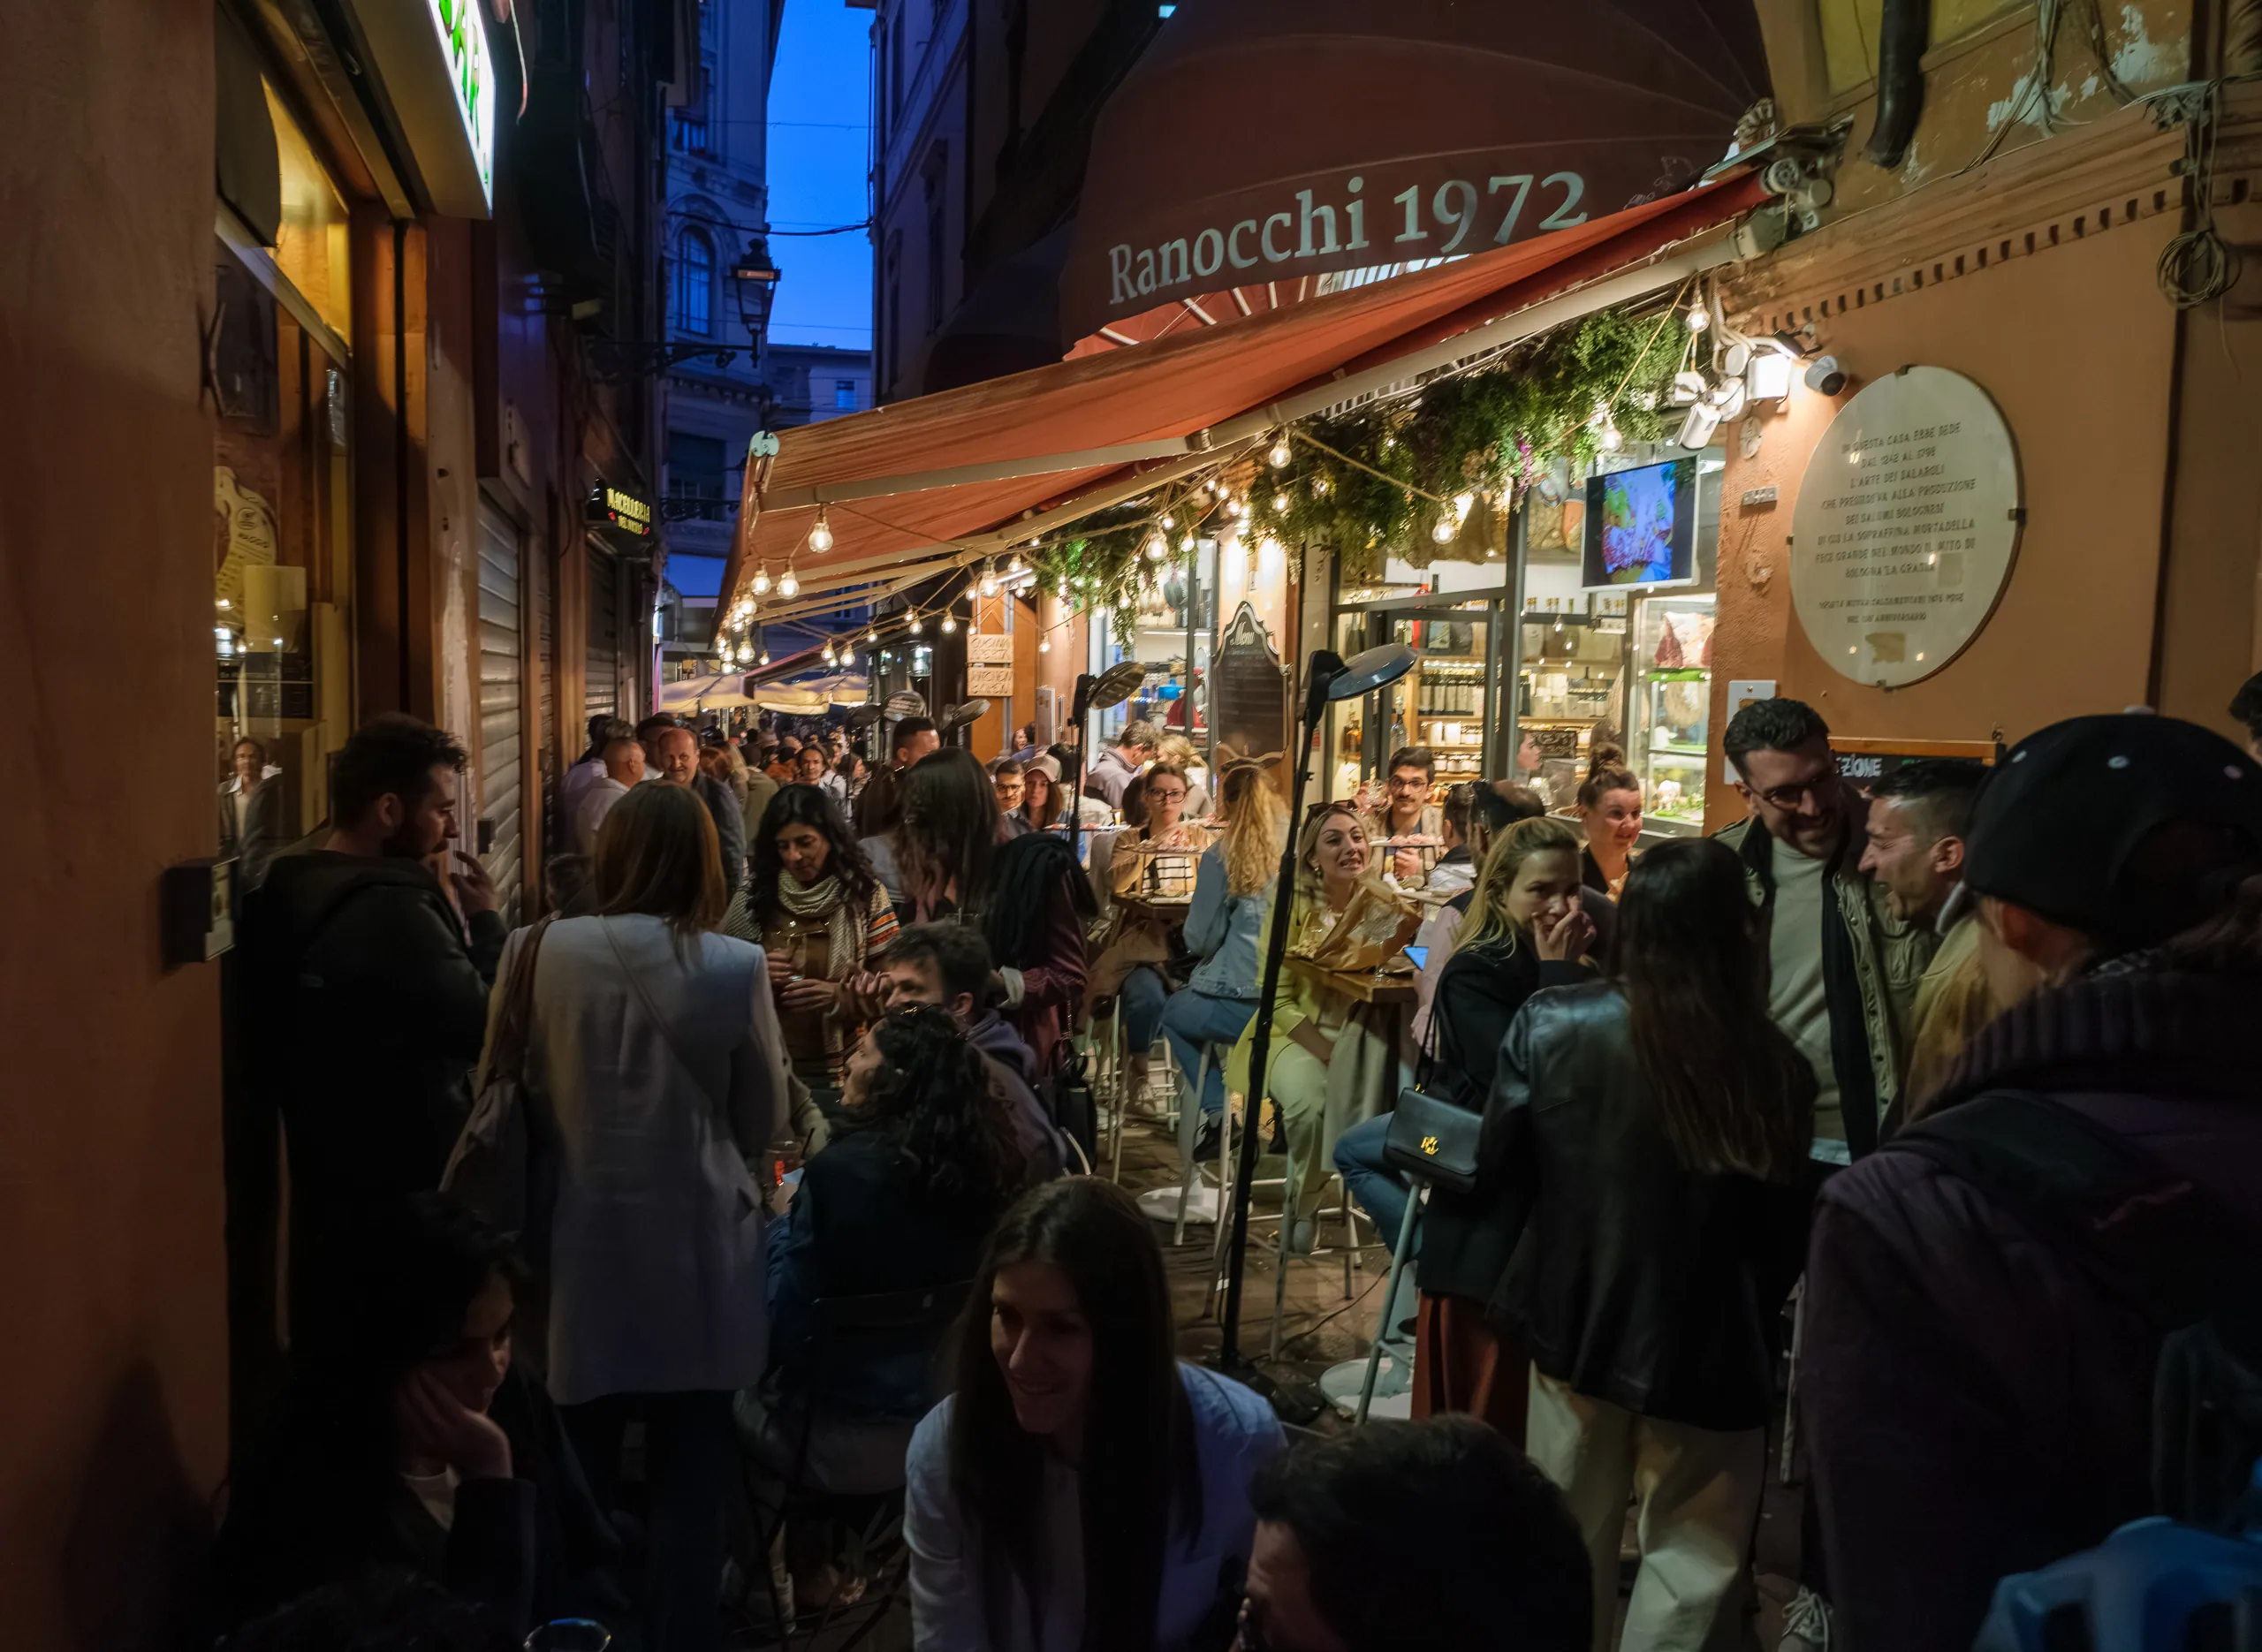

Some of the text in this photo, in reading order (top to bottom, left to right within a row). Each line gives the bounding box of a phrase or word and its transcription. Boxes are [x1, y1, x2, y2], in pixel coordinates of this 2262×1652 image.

[1109, 171, 1588, 305] Ranocchi 1972
[1887, 433, 1909, 445] CASA
[1861, 457, 1878, 469] DAL
[1901, 450, 1914, 461] AL
[1850, 474, 1880, 489] L'ARTE
[1884, 471, 1899, 483] DEI
[1891, 487, 1916, 500] ALLA
[1917, 478, 1977, 497] PRODUZIONE
[607, 488, 650, 523] MACELLERIA
[1896, 503, 1946, 519] BOLOGNESI
[1842, 532, 1854, 542] LA
[1912, 519, 1975, 534] MORTADELLA
[1835, 548, 1868, 561] GRANDE
[1891, 543, 1922, 557] MONDO
[1937, 540, 1962, 551] MITO
